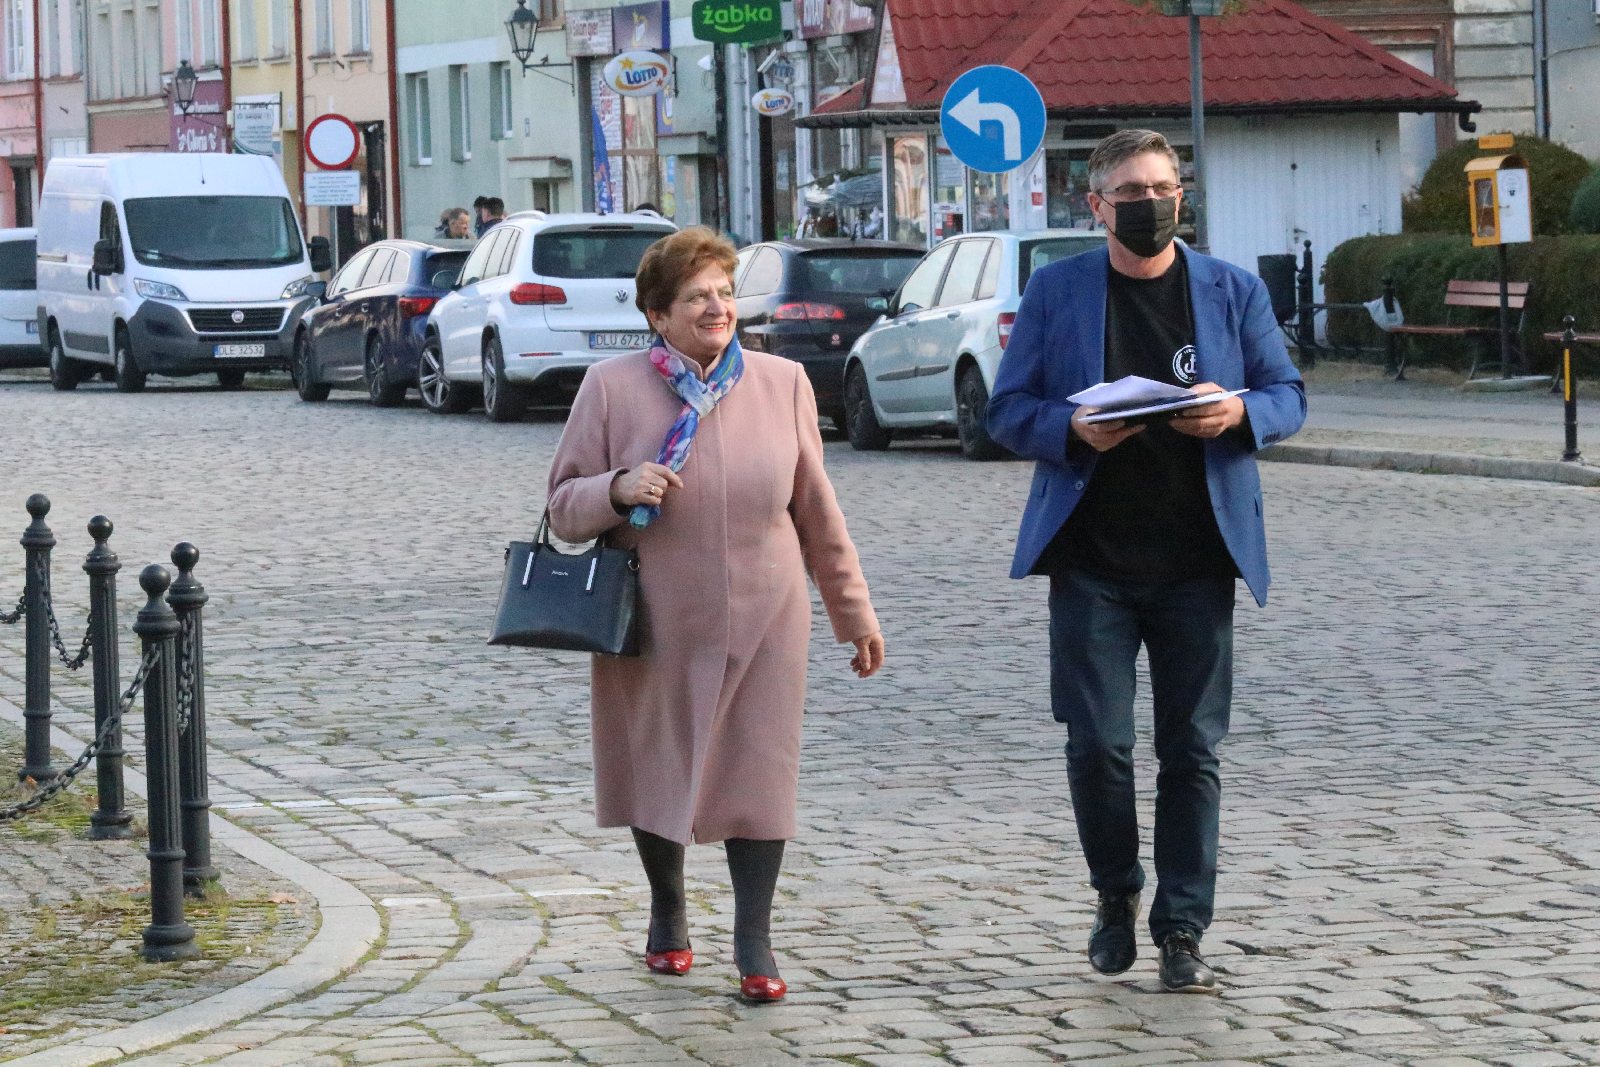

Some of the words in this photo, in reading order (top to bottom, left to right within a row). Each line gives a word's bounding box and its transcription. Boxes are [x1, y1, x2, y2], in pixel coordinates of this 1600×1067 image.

[703, 5, 773, 25] żabka
[625, 67, 658, 85] LOTTO
[596, 334, 617, 346] DLU
[620, 334, 653, 346] 67214
[219, 345, 237, 355] DLE
[239, 344, 264, 355] 32532
